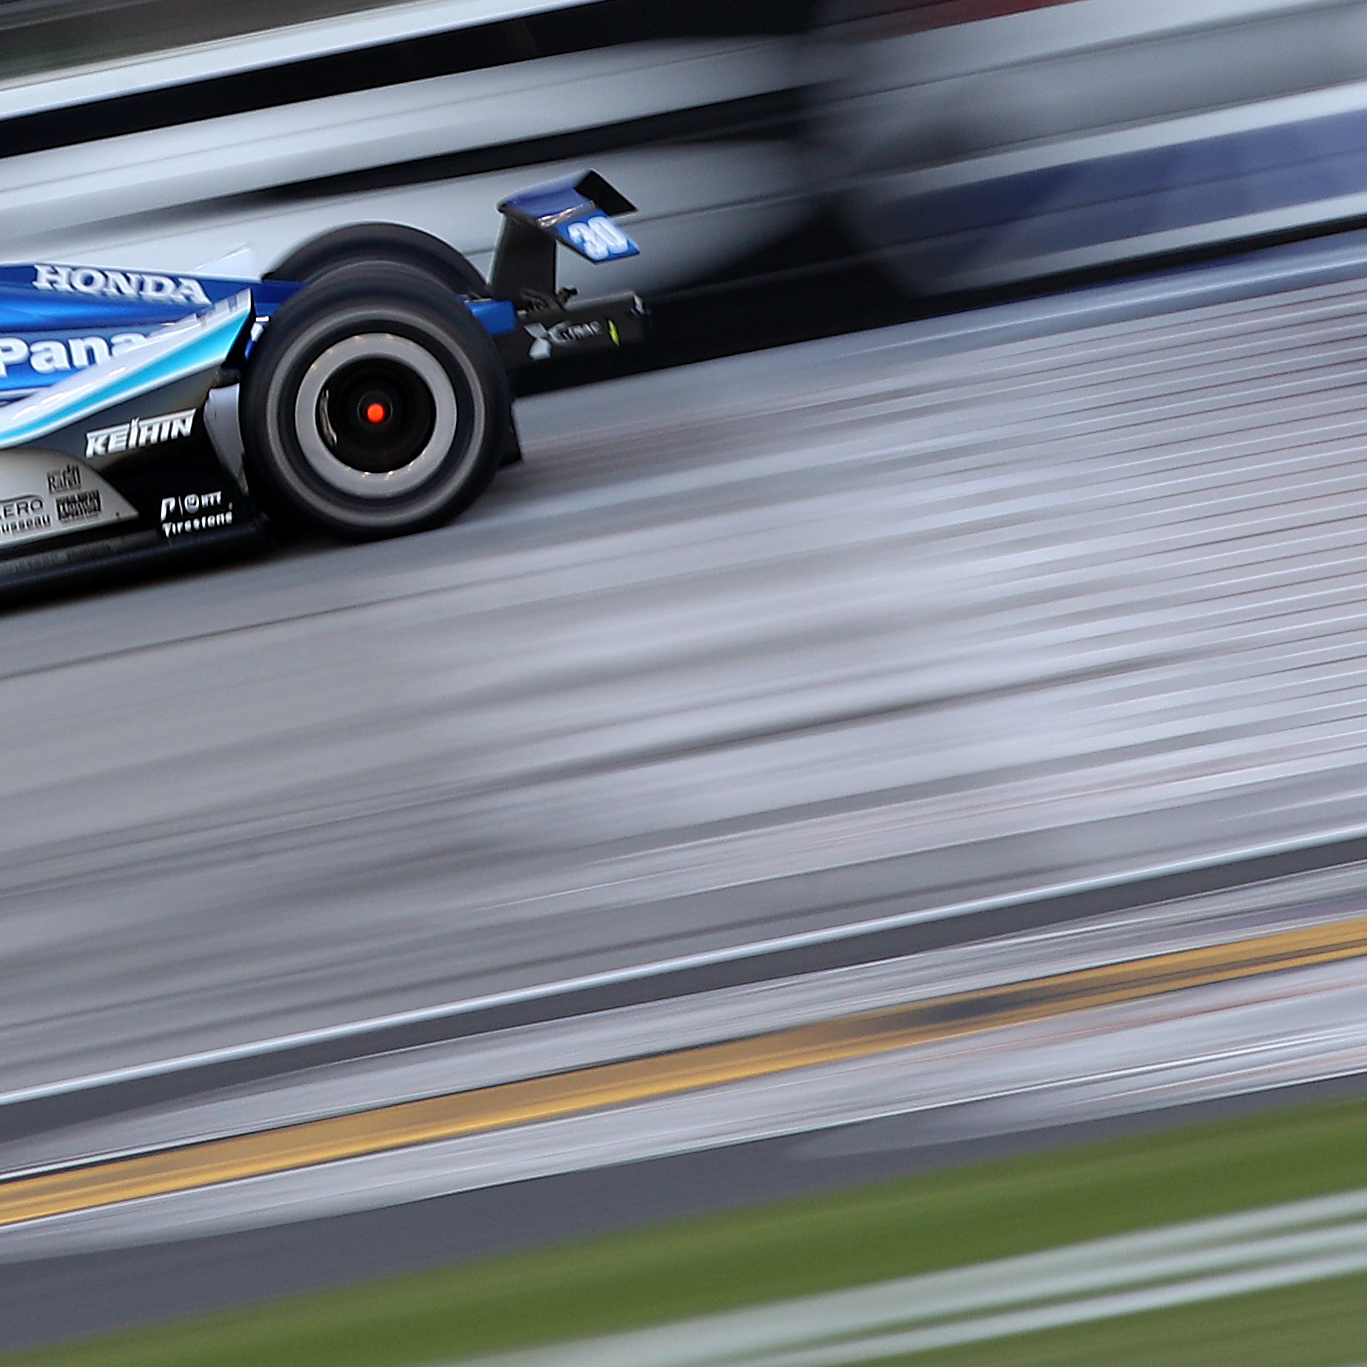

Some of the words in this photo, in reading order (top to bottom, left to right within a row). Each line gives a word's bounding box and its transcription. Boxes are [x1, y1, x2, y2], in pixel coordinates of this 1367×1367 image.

[568, 216, 629, 260] 30
[32, 264, 213, 305] HONDA
[85, 408, 197, 458] KEIHIN
[161, 510, 233, 538] Firestone
